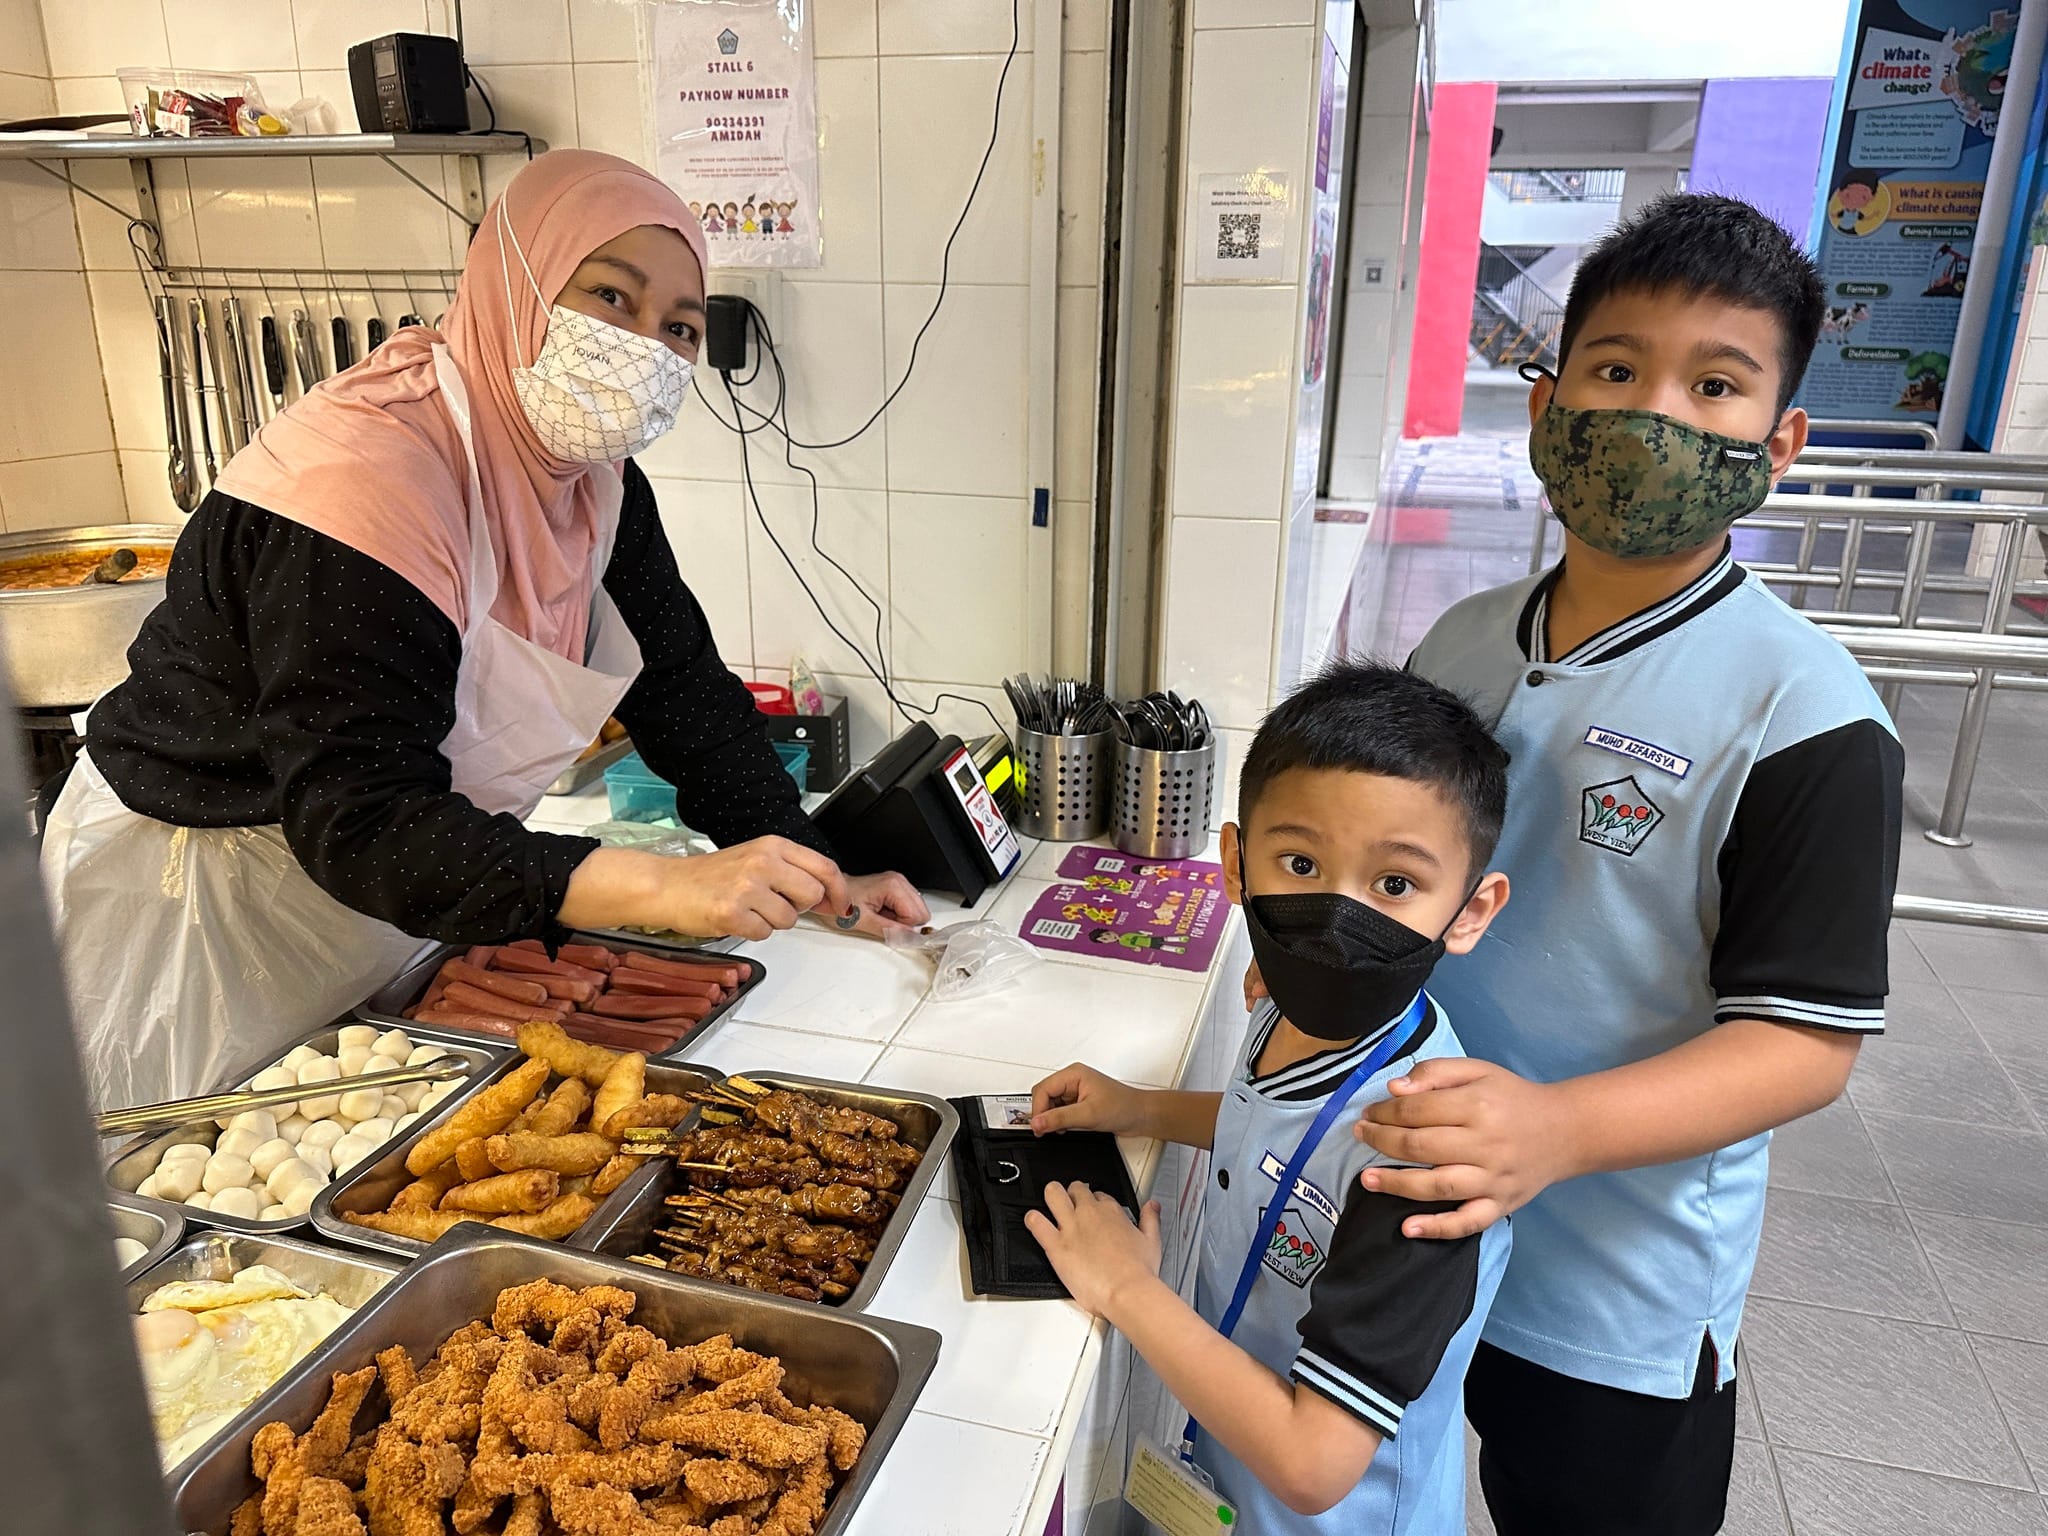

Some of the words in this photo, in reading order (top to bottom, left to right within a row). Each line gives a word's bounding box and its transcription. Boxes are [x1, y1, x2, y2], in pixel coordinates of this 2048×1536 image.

[1884, 46, 1921, 60] What
[1923, 52, 1930, 60] is
[707, 61, 742, 73] STALL
[747, 61, 754, 72] 6
[1861, 61, 1932, 79] climate
[680, 90, 733, 102] PAYNOW
[737, 88, 790, 100] NUMBER
[1884, 81, 1932, 95] change?
[706, 116, 765, 128] 90234391
[711, 130, 761, 142] AMIDAH
[1900, 187, 1930, 198] What
[1932, 188, 1942, 198] is
[1945, 187, 1983, 199] causin
[1896, 201, 1940, 213] climate
[1942, 202, 1978, 216] chang
[1596, 733, 1623, 749] MUHD
[1624, 742, 1676, 770] AZFARSYA
[1583, 828, 1609, 842] WEST
[1610, 837, 1635, 850] VIEW
[1302, 1187, 1334, 1218] UMMAR
[1283, 1264, 1305, 1284] VIEW
